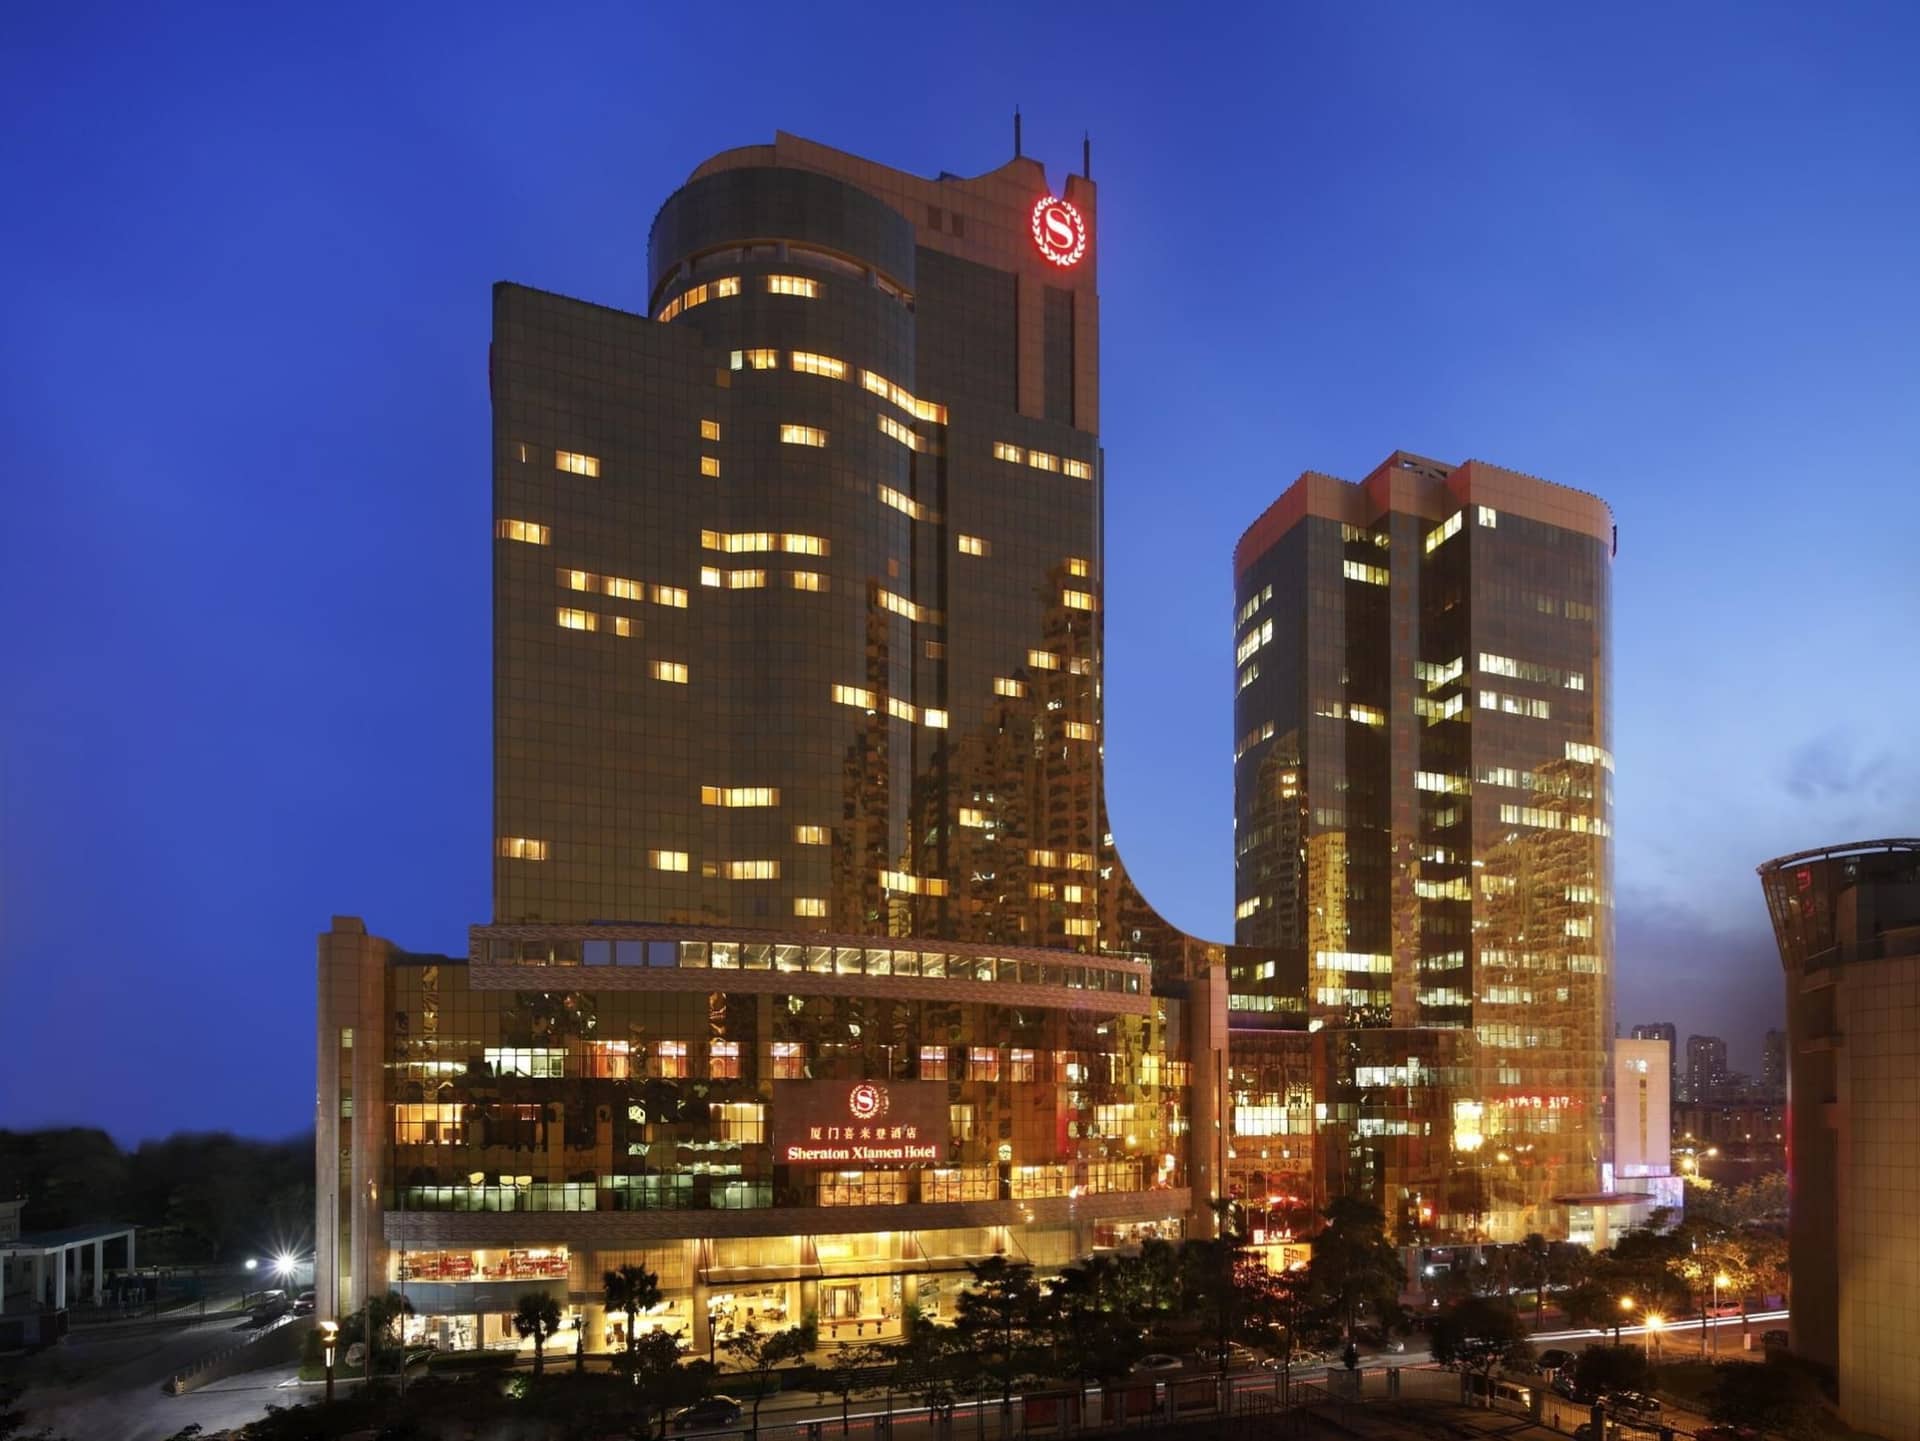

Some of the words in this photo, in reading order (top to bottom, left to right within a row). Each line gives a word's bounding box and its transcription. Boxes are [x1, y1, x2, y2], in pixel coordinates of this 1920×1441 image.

[1046, 208, 1073, 249] S
[857, 1089, 873, 1111] S
[788, 1146, 849, 1160] Sheraton
[852, 1146, 902, 1159] Xiamen
[905, 1145, 936, 1158] Hotel
